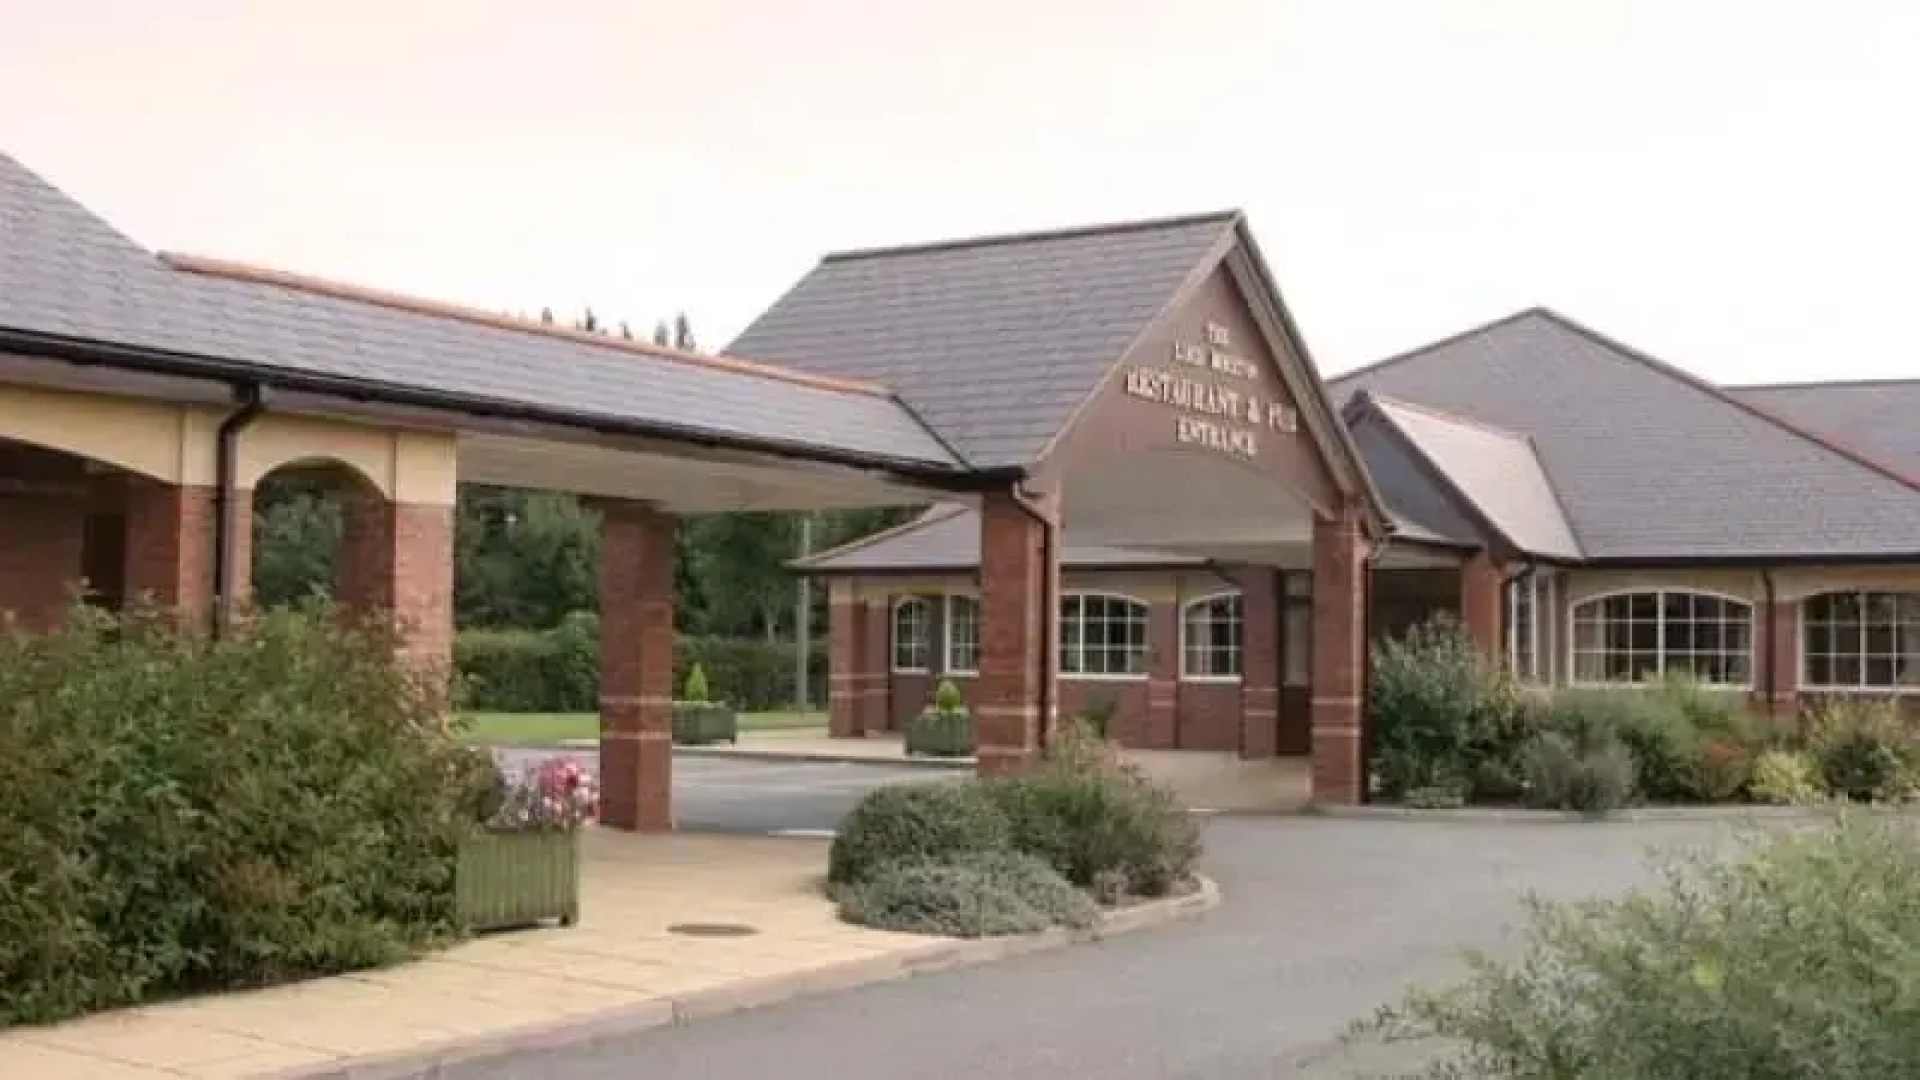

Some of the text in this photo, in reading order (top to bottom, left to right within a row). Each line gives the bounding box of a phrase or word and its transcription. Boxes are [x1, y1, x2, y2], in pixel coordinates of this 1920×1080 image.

[1126, 365, 1240, 417] RESTAURANT
[1247, 395, 1261, 423] &
[1176, 416, 1258, 457] ENTRANCE
